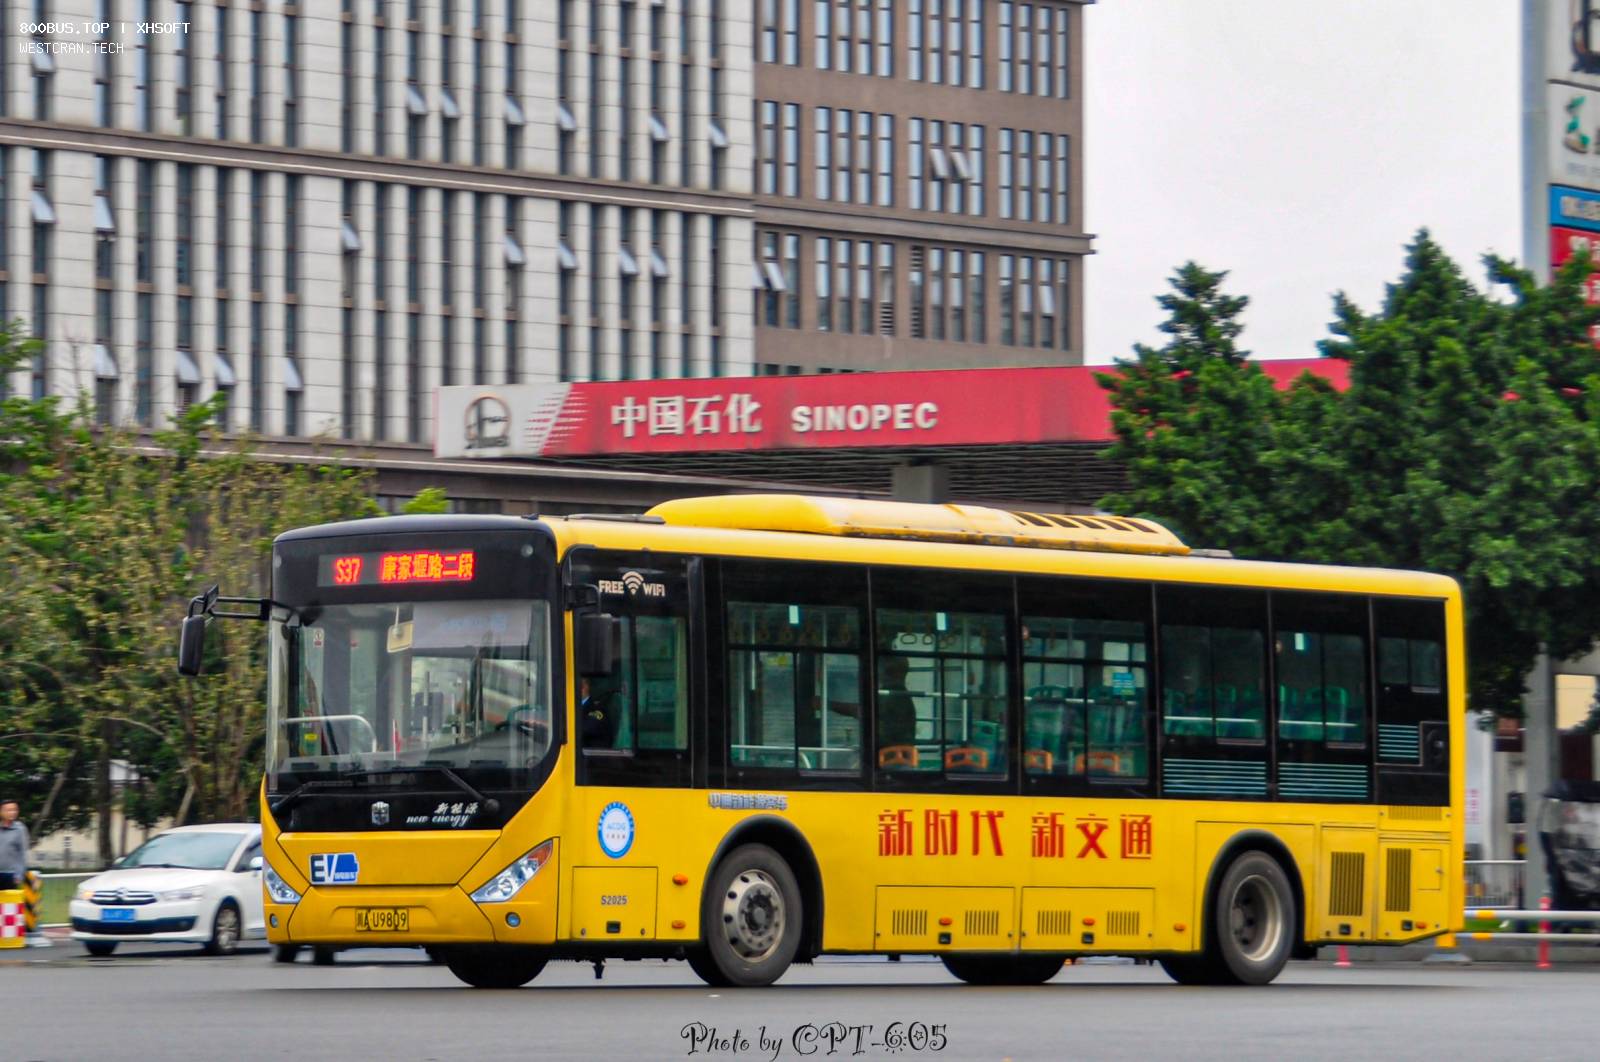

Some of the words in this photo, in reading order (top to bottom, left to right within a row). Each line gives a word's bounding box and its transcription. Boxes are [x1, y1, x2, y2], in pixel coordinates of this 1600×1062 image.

[611, 393, 763, 438] 中国石化
[791, 402, 938, 432] SINOPEC
[335, 558, 361, 583] S37
[598, 580, 624, 594] FREE
[642, 582, 666, 597] WIFI
[406, 815, 429, 824] new
[431, 814, 470, 827] energy
[434, 802, 478, 815] 新能源
[878, 809, 1004, 857] 新时代
[1031, 812, 1152, 860] 新交通
[310, 853, 339, 883] EV
